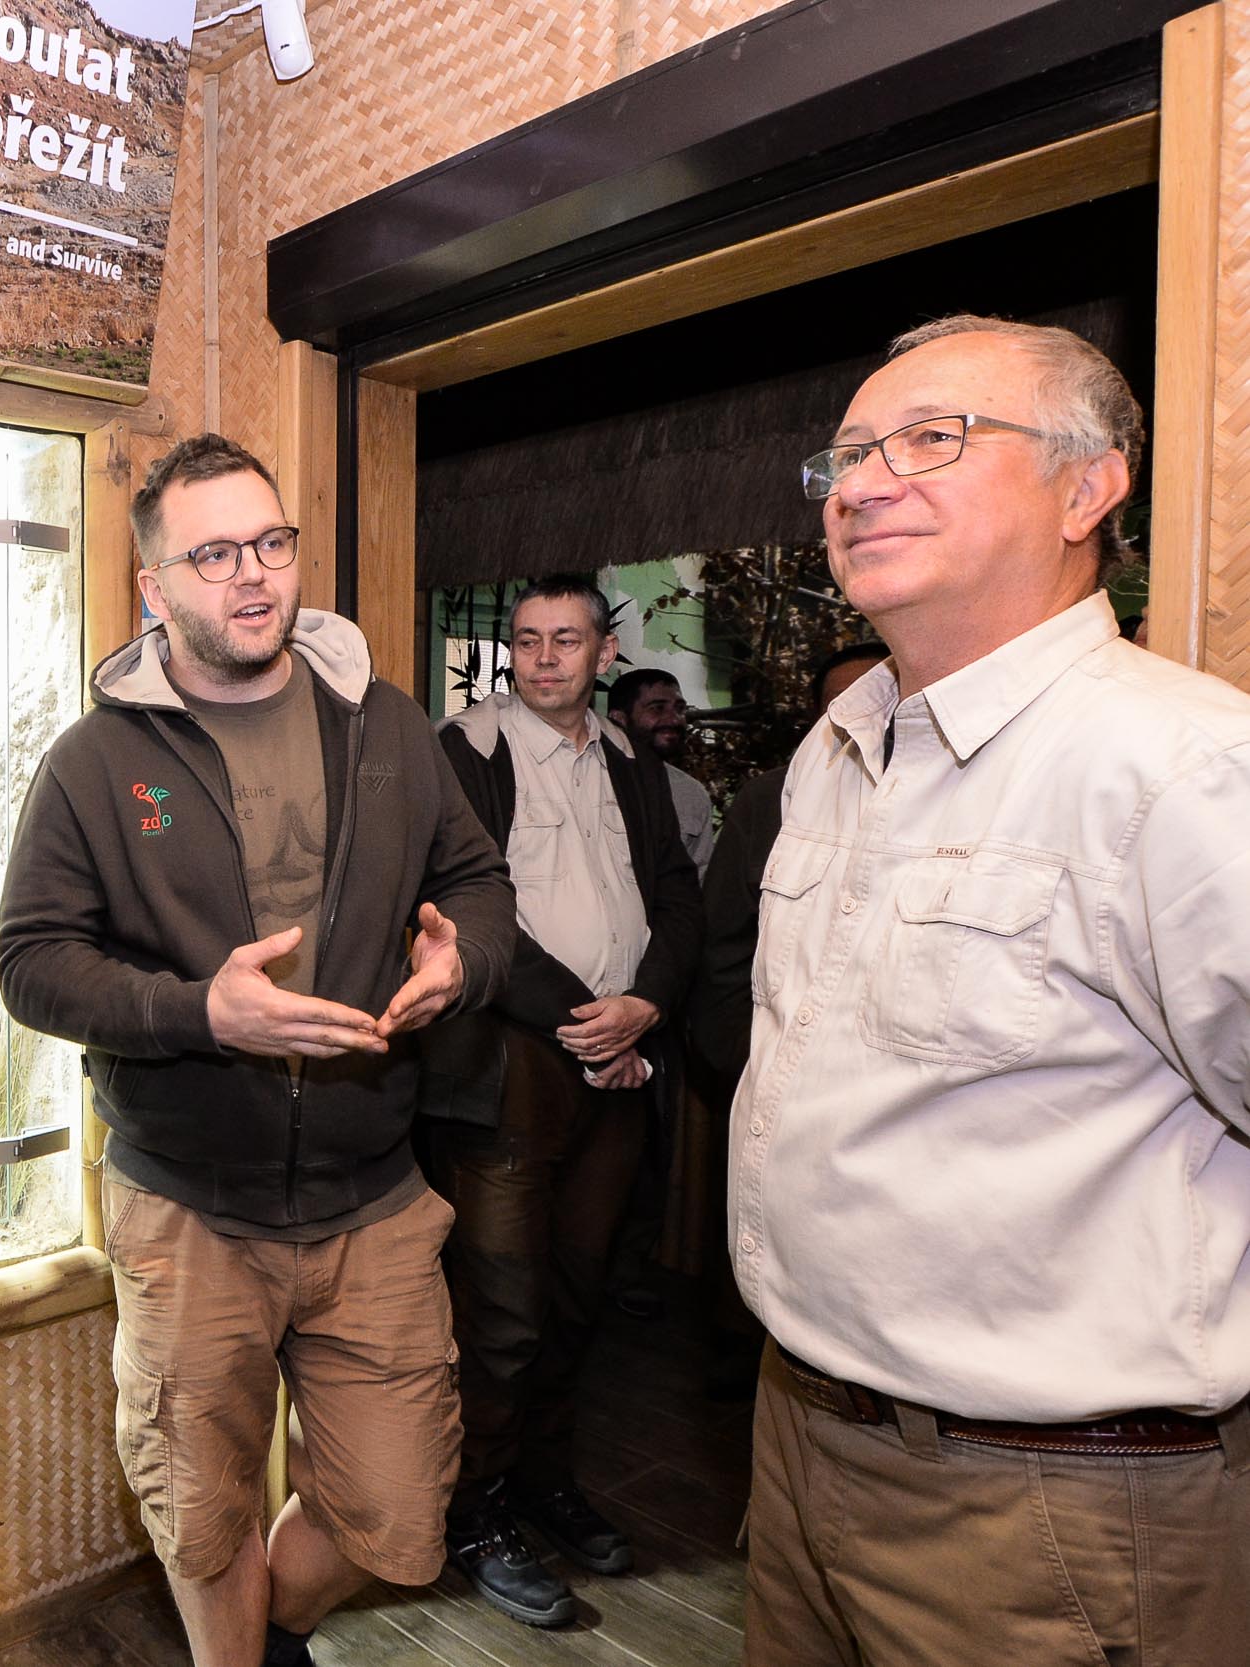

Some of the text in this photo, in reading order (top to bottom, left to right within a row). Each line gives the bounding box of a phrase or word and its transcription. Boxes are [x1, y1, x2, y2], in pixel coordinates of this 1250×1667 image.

[6, 235, 47, 261] and
[51, 244, 123, 281] Survive
[232, 784, 276, 802] ature
